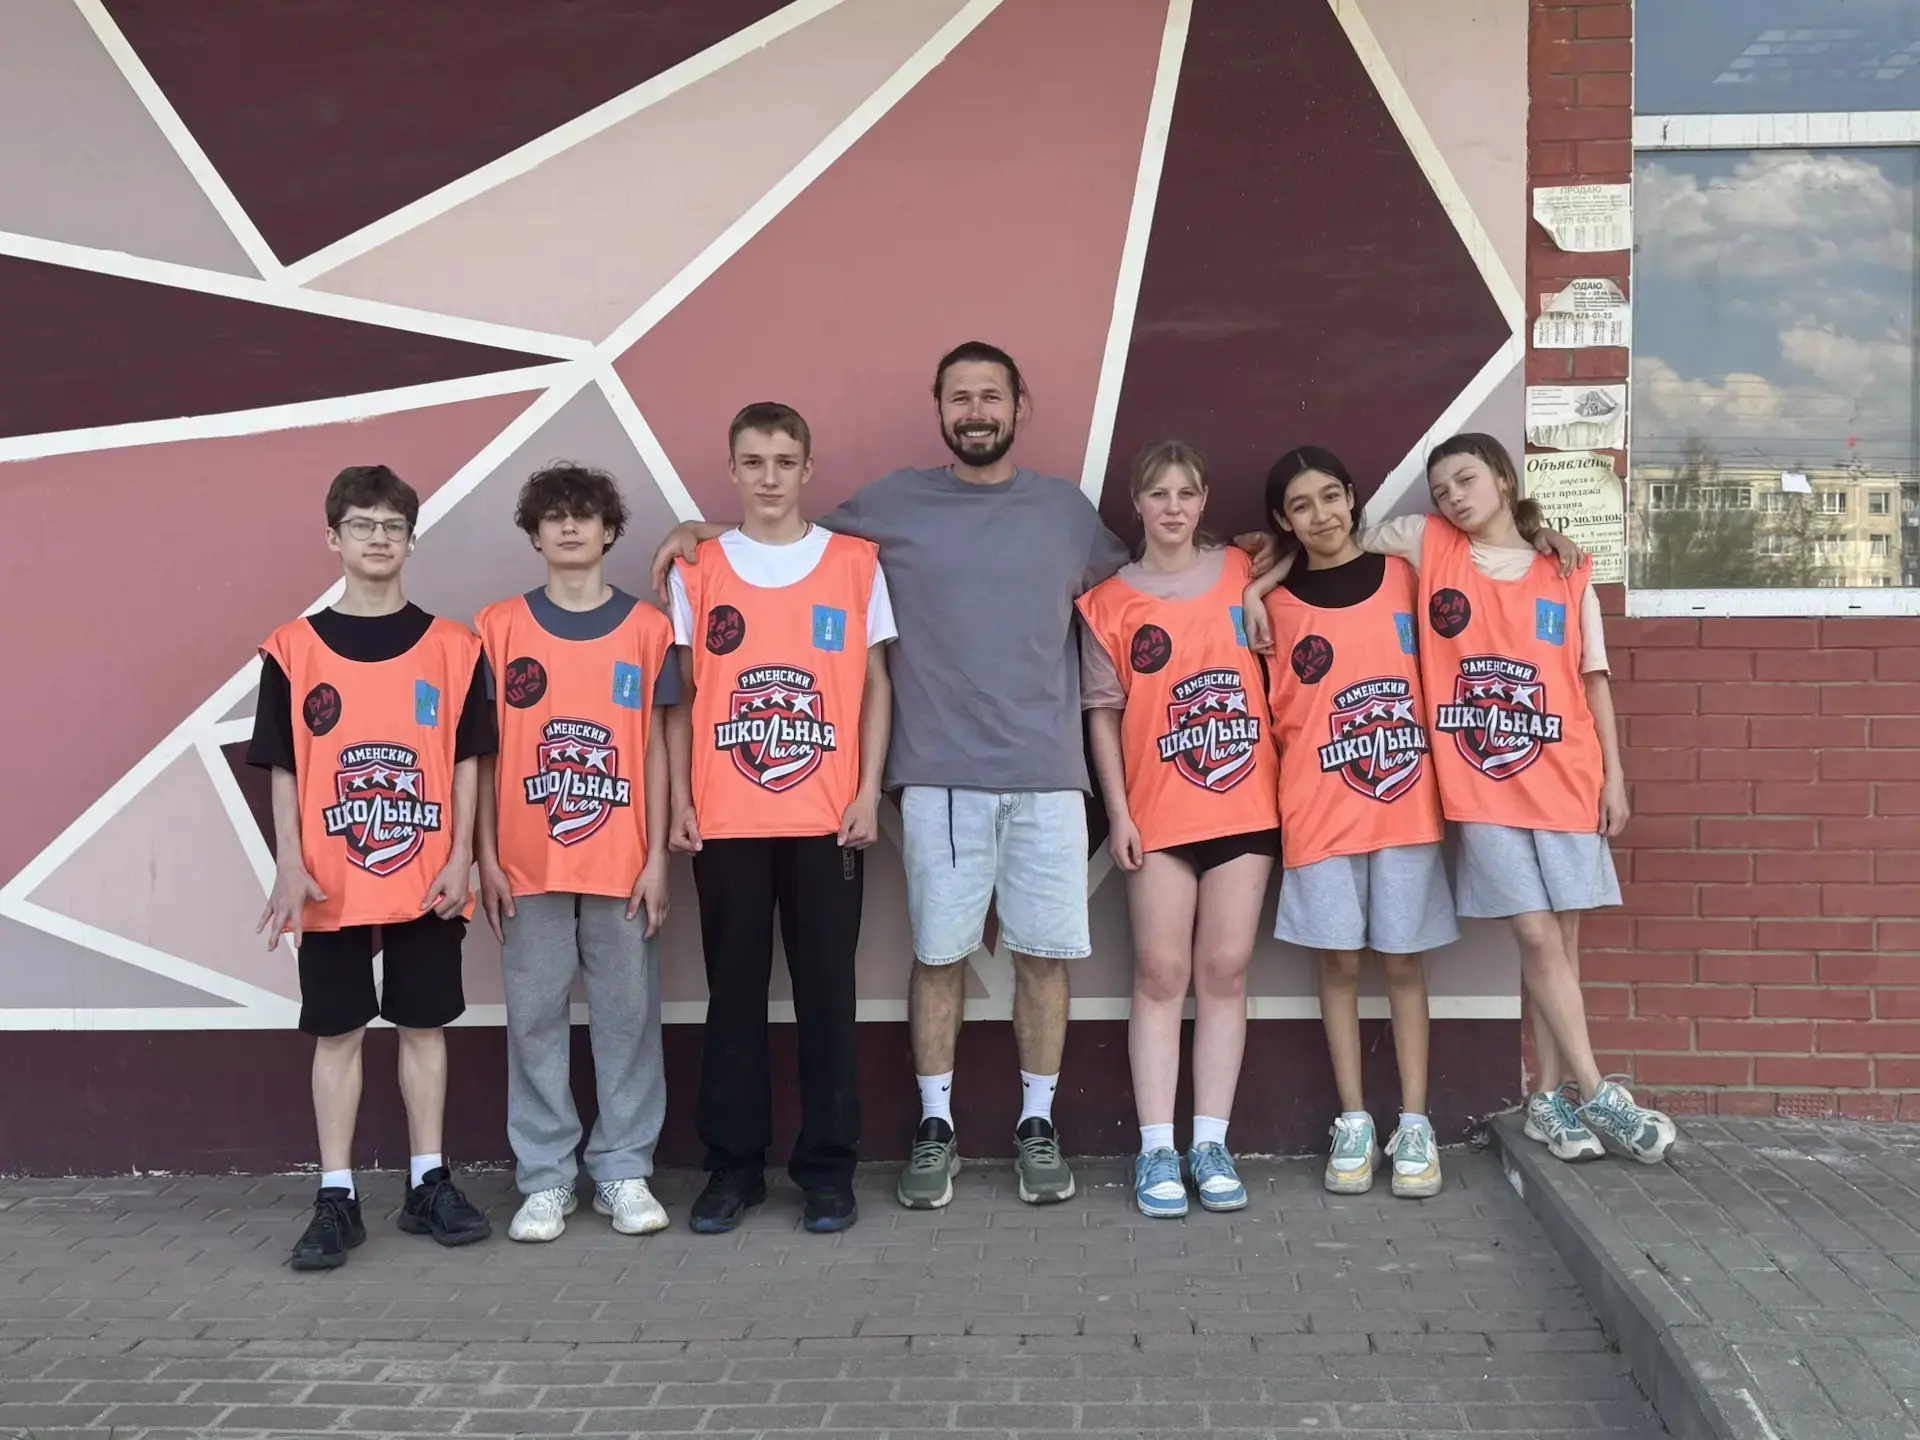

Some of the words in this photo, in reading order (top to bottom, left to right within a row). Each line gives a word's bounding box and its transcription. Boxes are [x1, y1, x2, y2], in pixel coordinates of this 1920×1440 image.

[1560, 186, 1602, 195] ПРОДАЮ
[1572, 282, 1603, 290] ОДАЮ
[1576, 312, 1613, 320] 478-01-22
[1527, 458, 1612, 473] Объявление
[1559, 488, 1601, 499] продажа
[1545, 513, 1622, 533] ур-молодок
[717, 718, 836, 749] ШКОЛЬНАЯ
[755, 714, 815, 765] Лига
[1159, 719, 1260, 759] ШКОЛЬНЯ
[526, 771, 630, 804] ШОЛЬНАЯ
[549, 768, 602, 817] Лига
